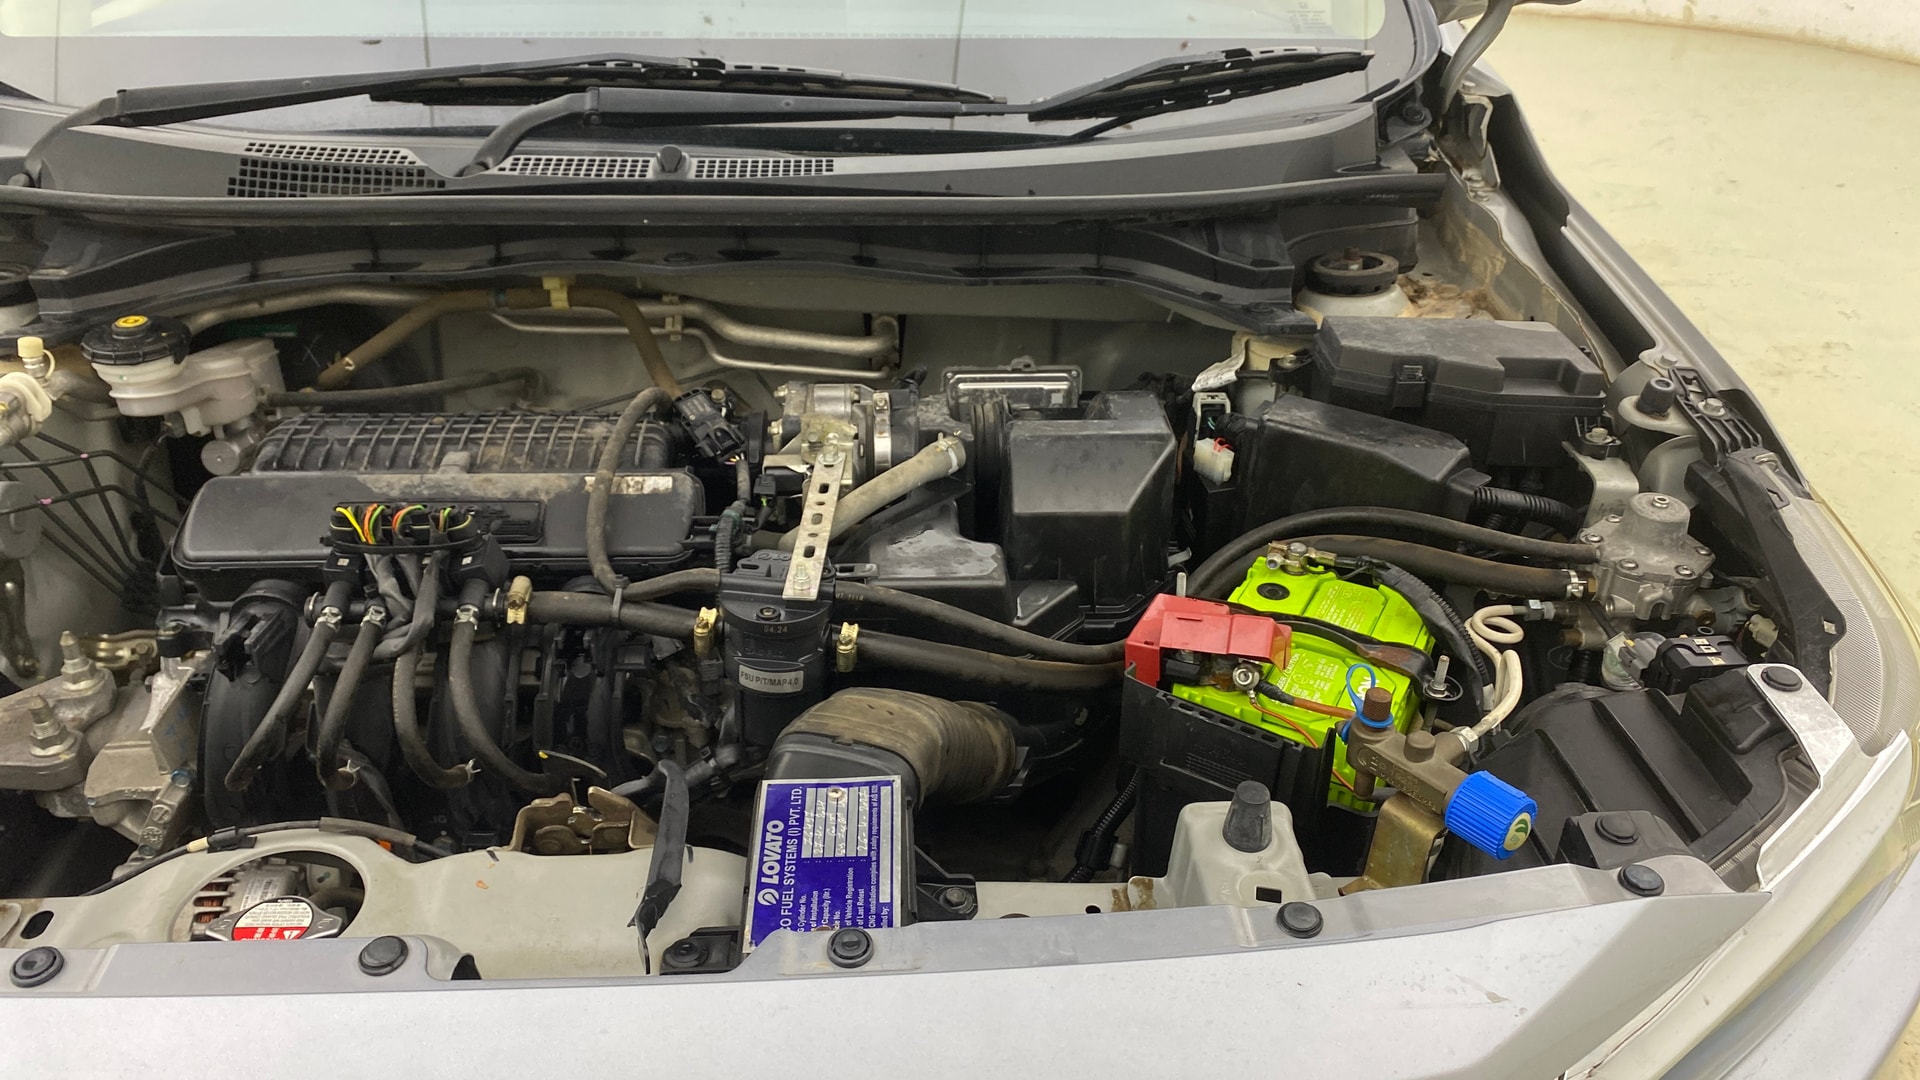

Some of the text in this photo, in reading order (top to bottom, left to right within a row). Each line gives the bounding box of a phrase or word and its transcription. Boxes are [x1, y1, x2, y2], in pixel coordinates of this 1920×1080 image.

[1286, 653, 1300, 673] CAUTION
[740, 670, 754, 682] FSU
[790, 786, 803, 806] LTD.
[789, 807, 801, 826] PVT.
[788, 827, 802, 837] (I)
[761, 820, 785, 884] LOVATO
[784, 838, 798, 886] SYSTEMS
[846, 868, 854, 898] Registration
[781, 887, 794, 915] FUEL
[810, 891, 818, 920] Installation
[822, 900, 831, 923] Capacity
[798, 904, 806, 926] Cylinder
